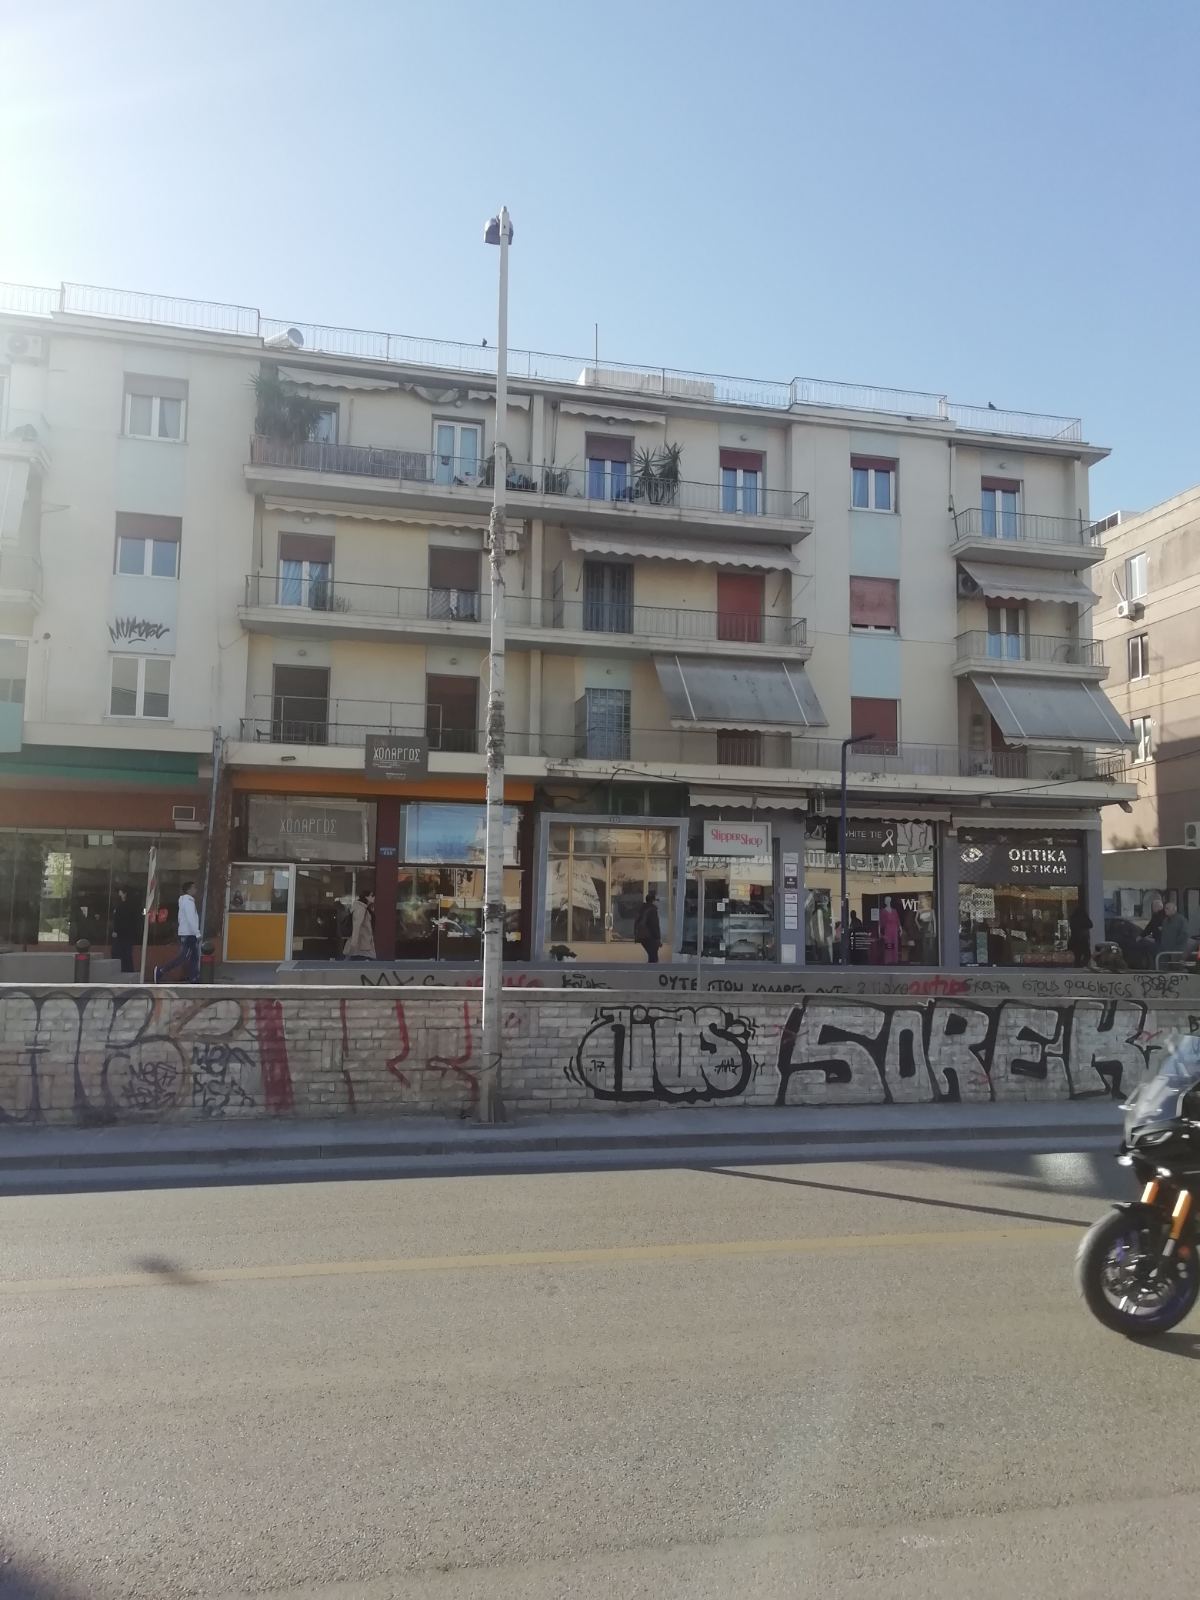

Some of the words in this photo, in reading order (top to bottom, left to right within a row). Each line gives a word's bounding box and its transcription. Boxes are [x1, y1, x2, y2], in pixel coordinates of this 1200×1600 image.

[373, 746, 421, 762] ΧΟΛΑΡΓΟΣ
[279, 817, 337, 834] ΧΟΛΑΡΓΟΣ
[870, 830, 883, 839] TIE
[1008, 848, 1067, 862] ΟΠΤΙΚΑ
